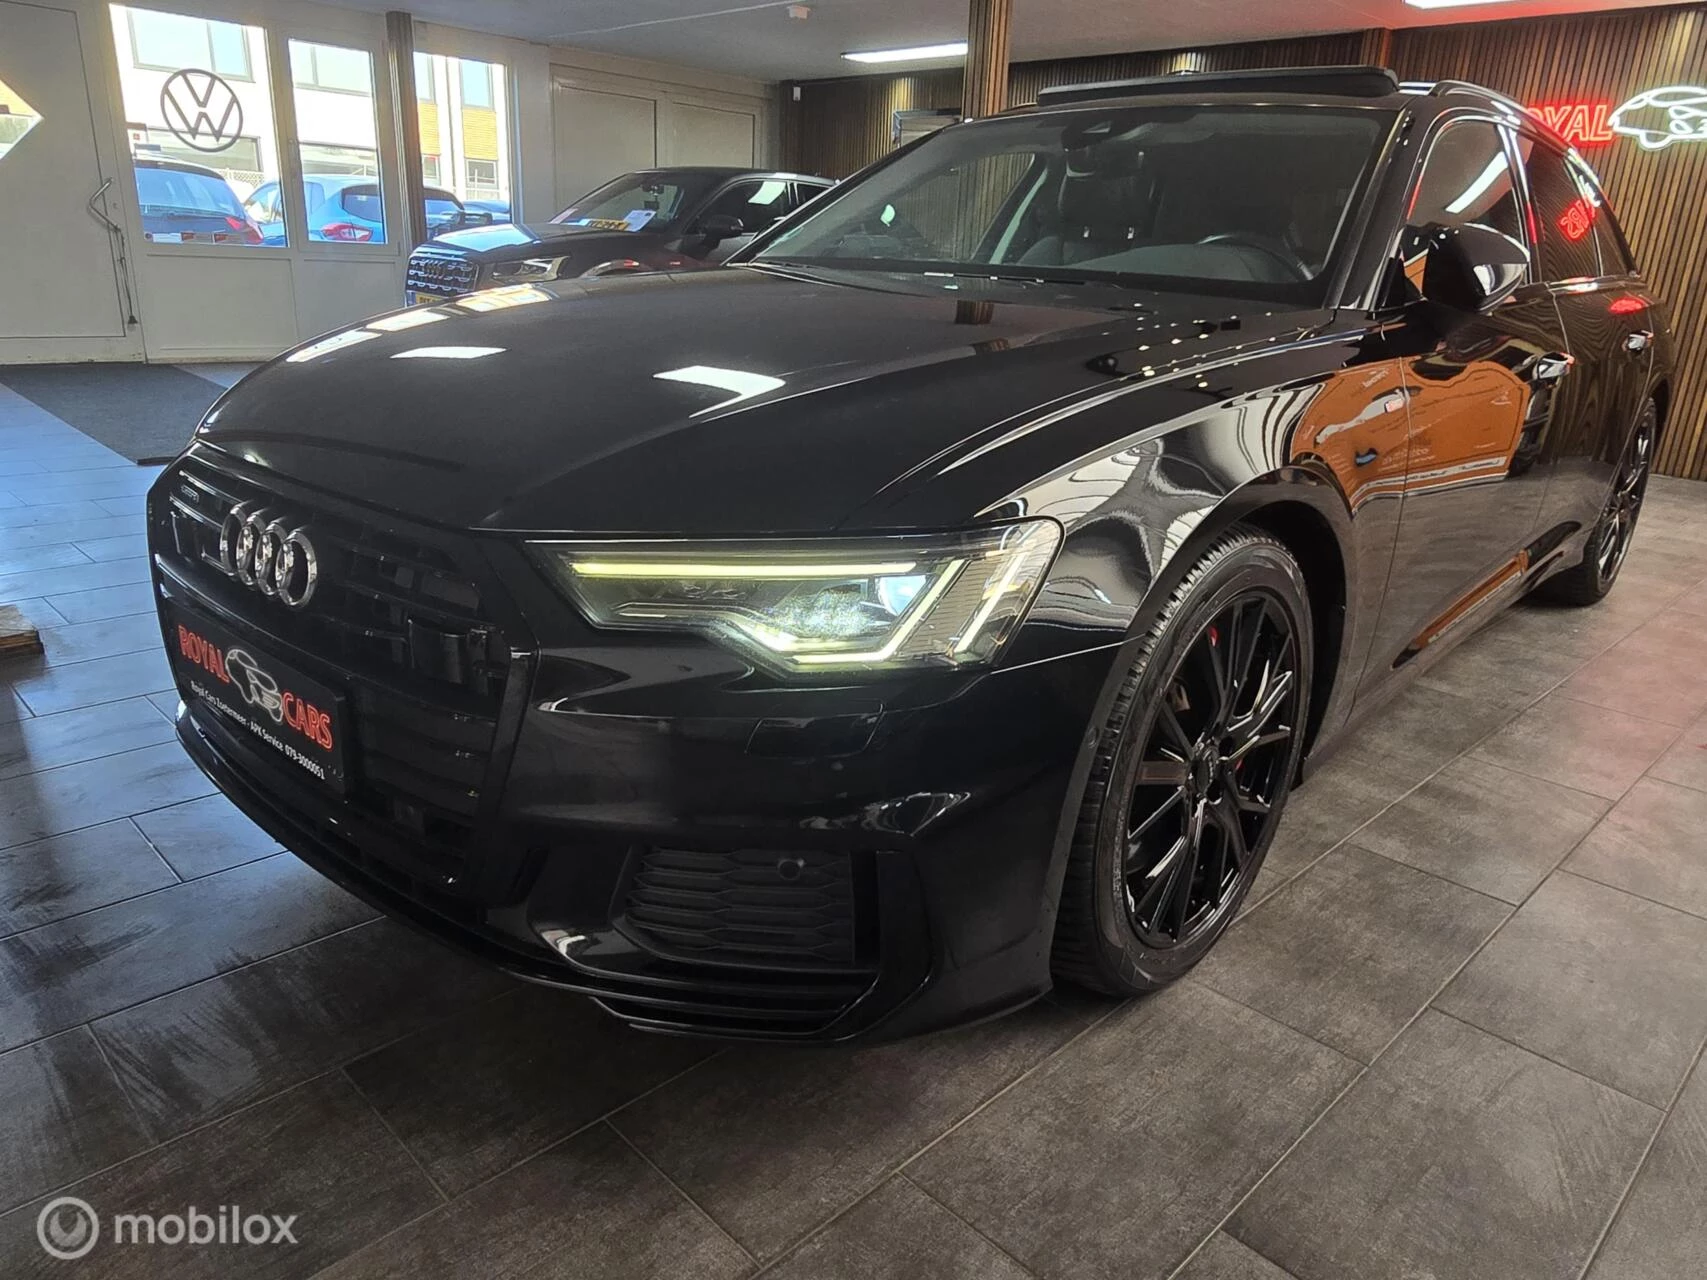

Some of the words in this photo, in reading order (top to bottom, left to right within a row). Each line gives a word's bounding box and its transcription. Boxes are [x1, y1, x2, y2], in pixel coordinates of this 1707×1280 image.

[1527, 104, 1613, 141] YAL
[178, 625, 230, 683] ROYAL
[282, 691, 333, 749] CARS
